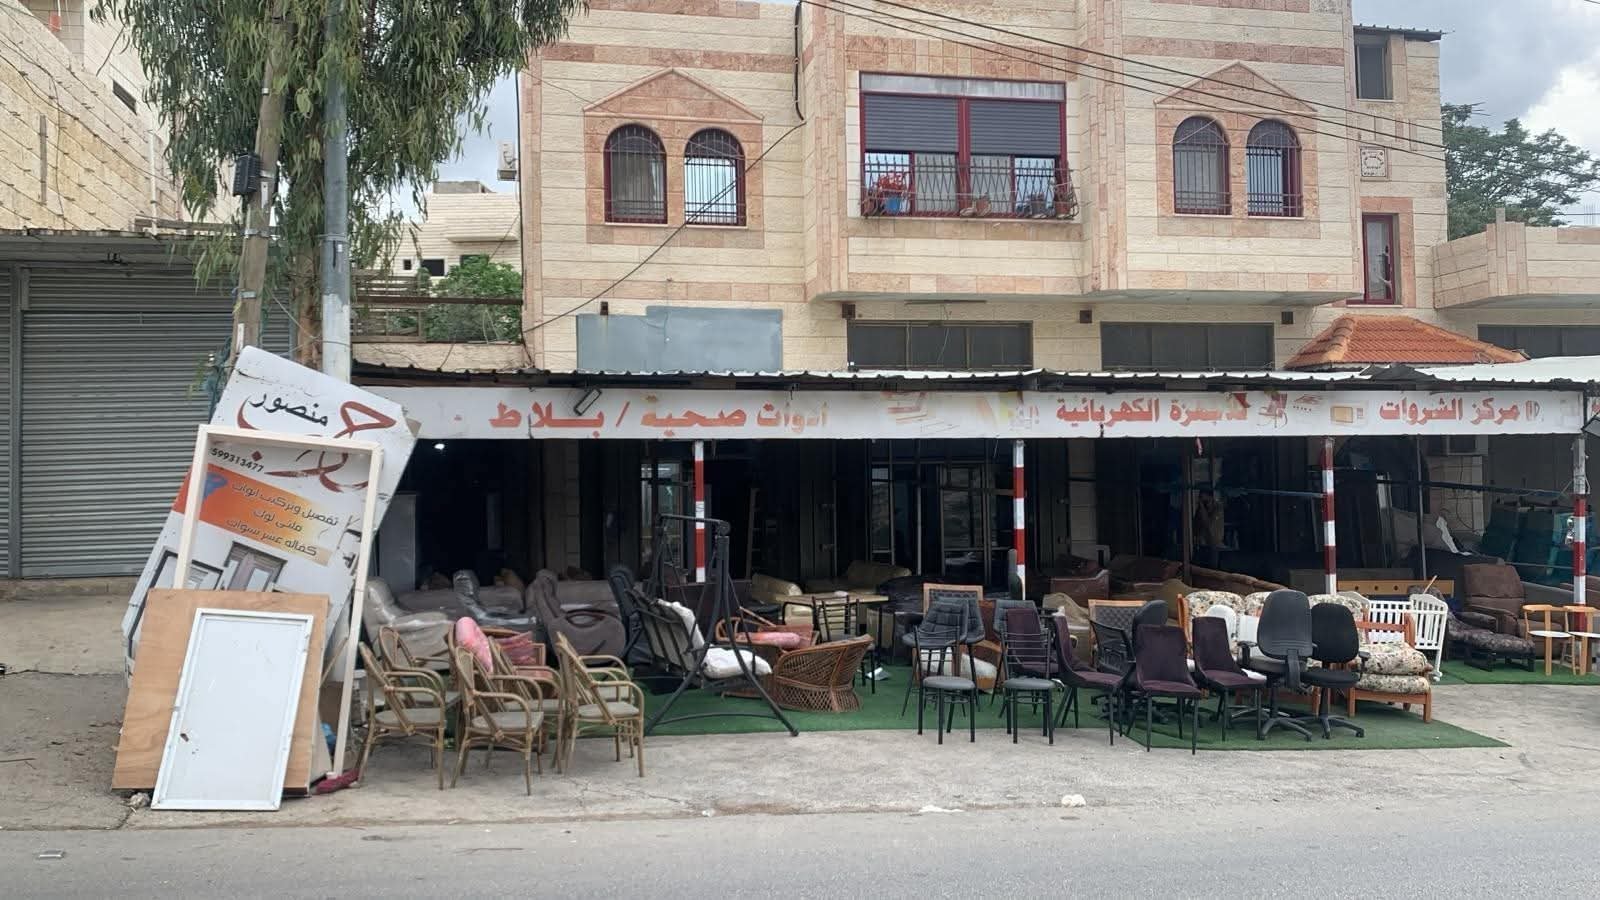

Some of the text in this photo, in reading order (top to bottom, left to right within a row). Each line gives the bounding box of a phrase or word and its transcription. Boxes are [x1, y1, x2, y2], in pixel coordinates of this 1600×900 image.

[248, 393, 328, 426] منصور
[640, 394, 747, 437] صحية
[1056, 397, 1159, 427] الكهربائية
[1471, 397, 1520, 425] مركز
[302, 509, 338, 526] تفصيل
